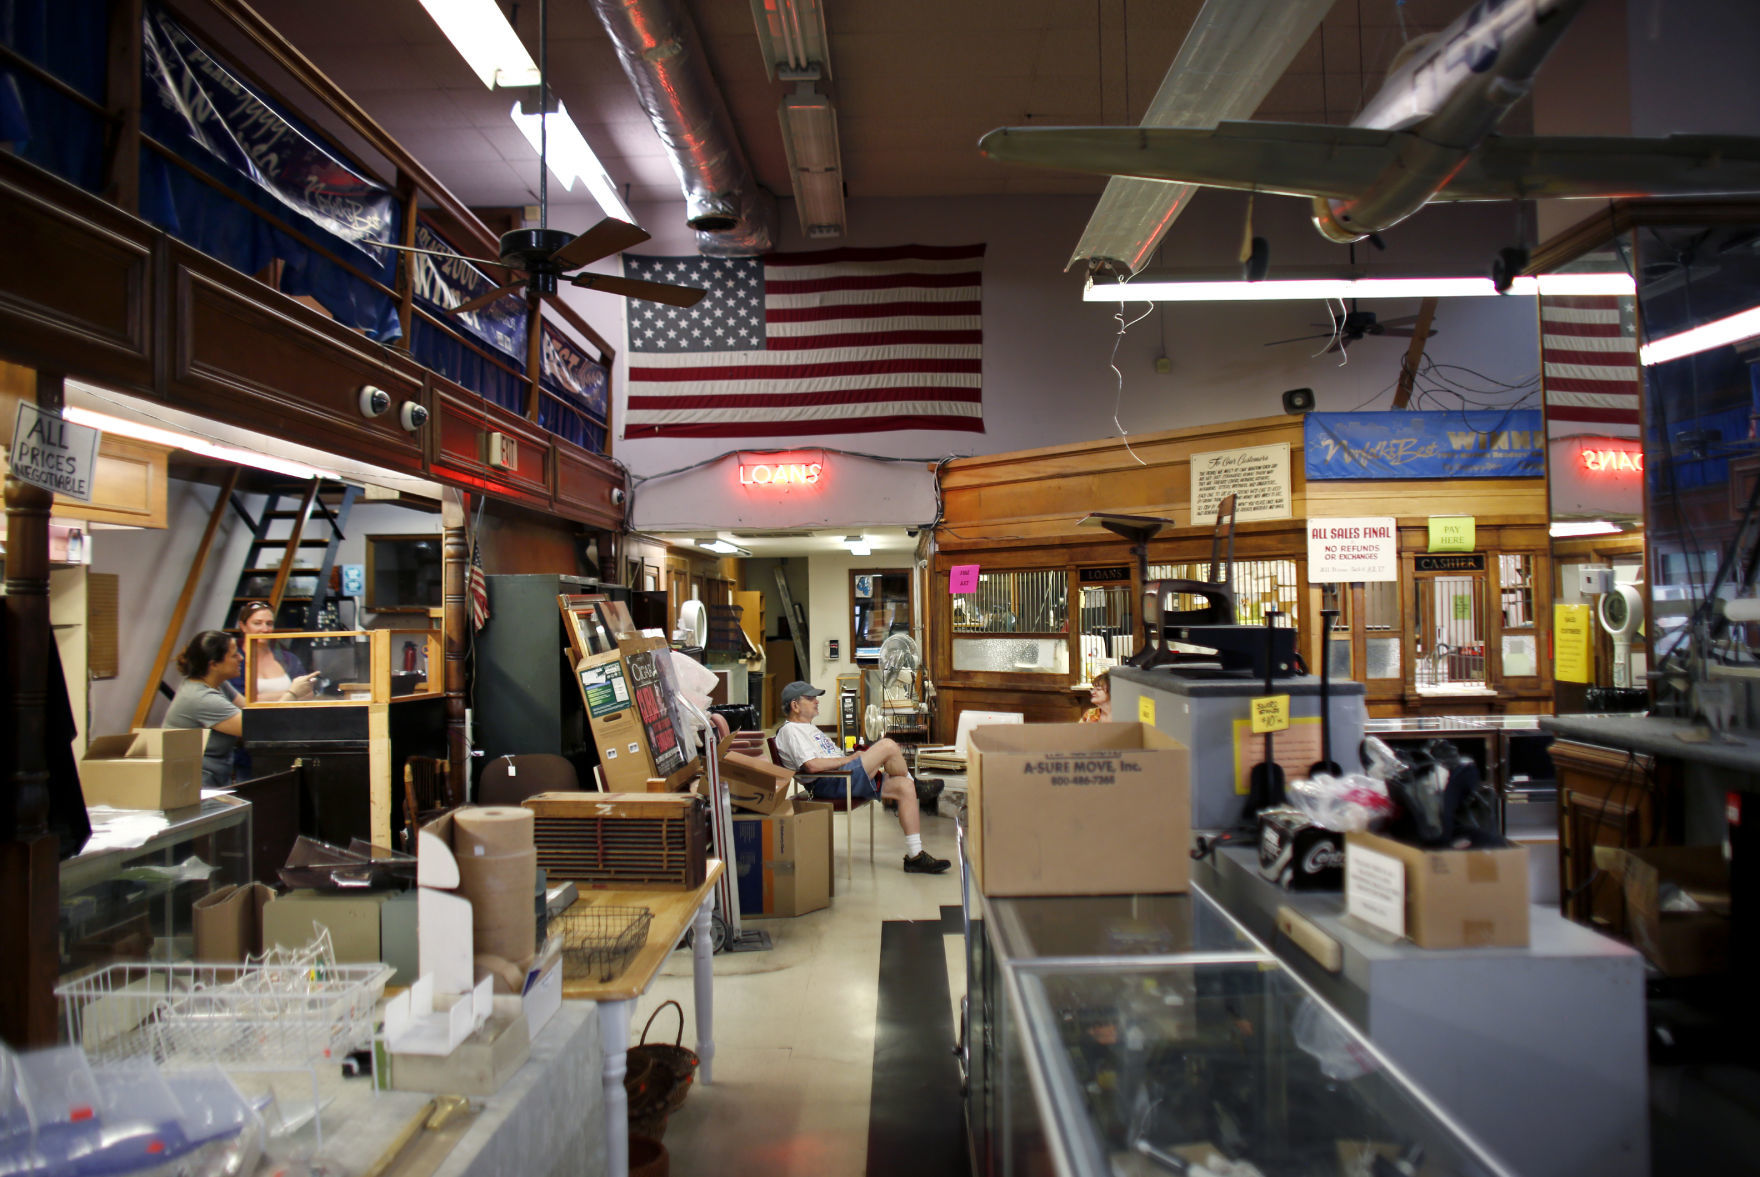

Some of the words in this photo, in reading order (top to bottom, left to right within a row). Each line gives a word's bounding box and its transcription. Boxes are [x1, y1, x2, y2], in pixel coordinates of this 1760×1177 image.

[26, 417, 69, 450] ALL
[18, 442, 77, 475] PRICES
[14, 462, 87, 496] NEGOTIABLE
[739, 463, 822, 485] LOANS
[1312, 528, 1327, 540] ALL
[1330, 527, 1360, 540] SALES
[1363, 526, 1391, 539] FINAL
[1444, 525, 1461, 535] PAY
[1440, 536, 1465, 545] HERE
[1324, 545, 1338, 553] NO
[1340, 544, 1380, 553] REFUNDS
[1324, 553, 1336, 561] OR
[1338, 553, 1379, 561] EXCHANGES
[1421, 556, 1477, 570] CASHIER
[1088, 568, 1123, 580] LOANS
[1024, 761, 1070, 774] A-SURE
[1120, 760, 1142, 772] Inc.
